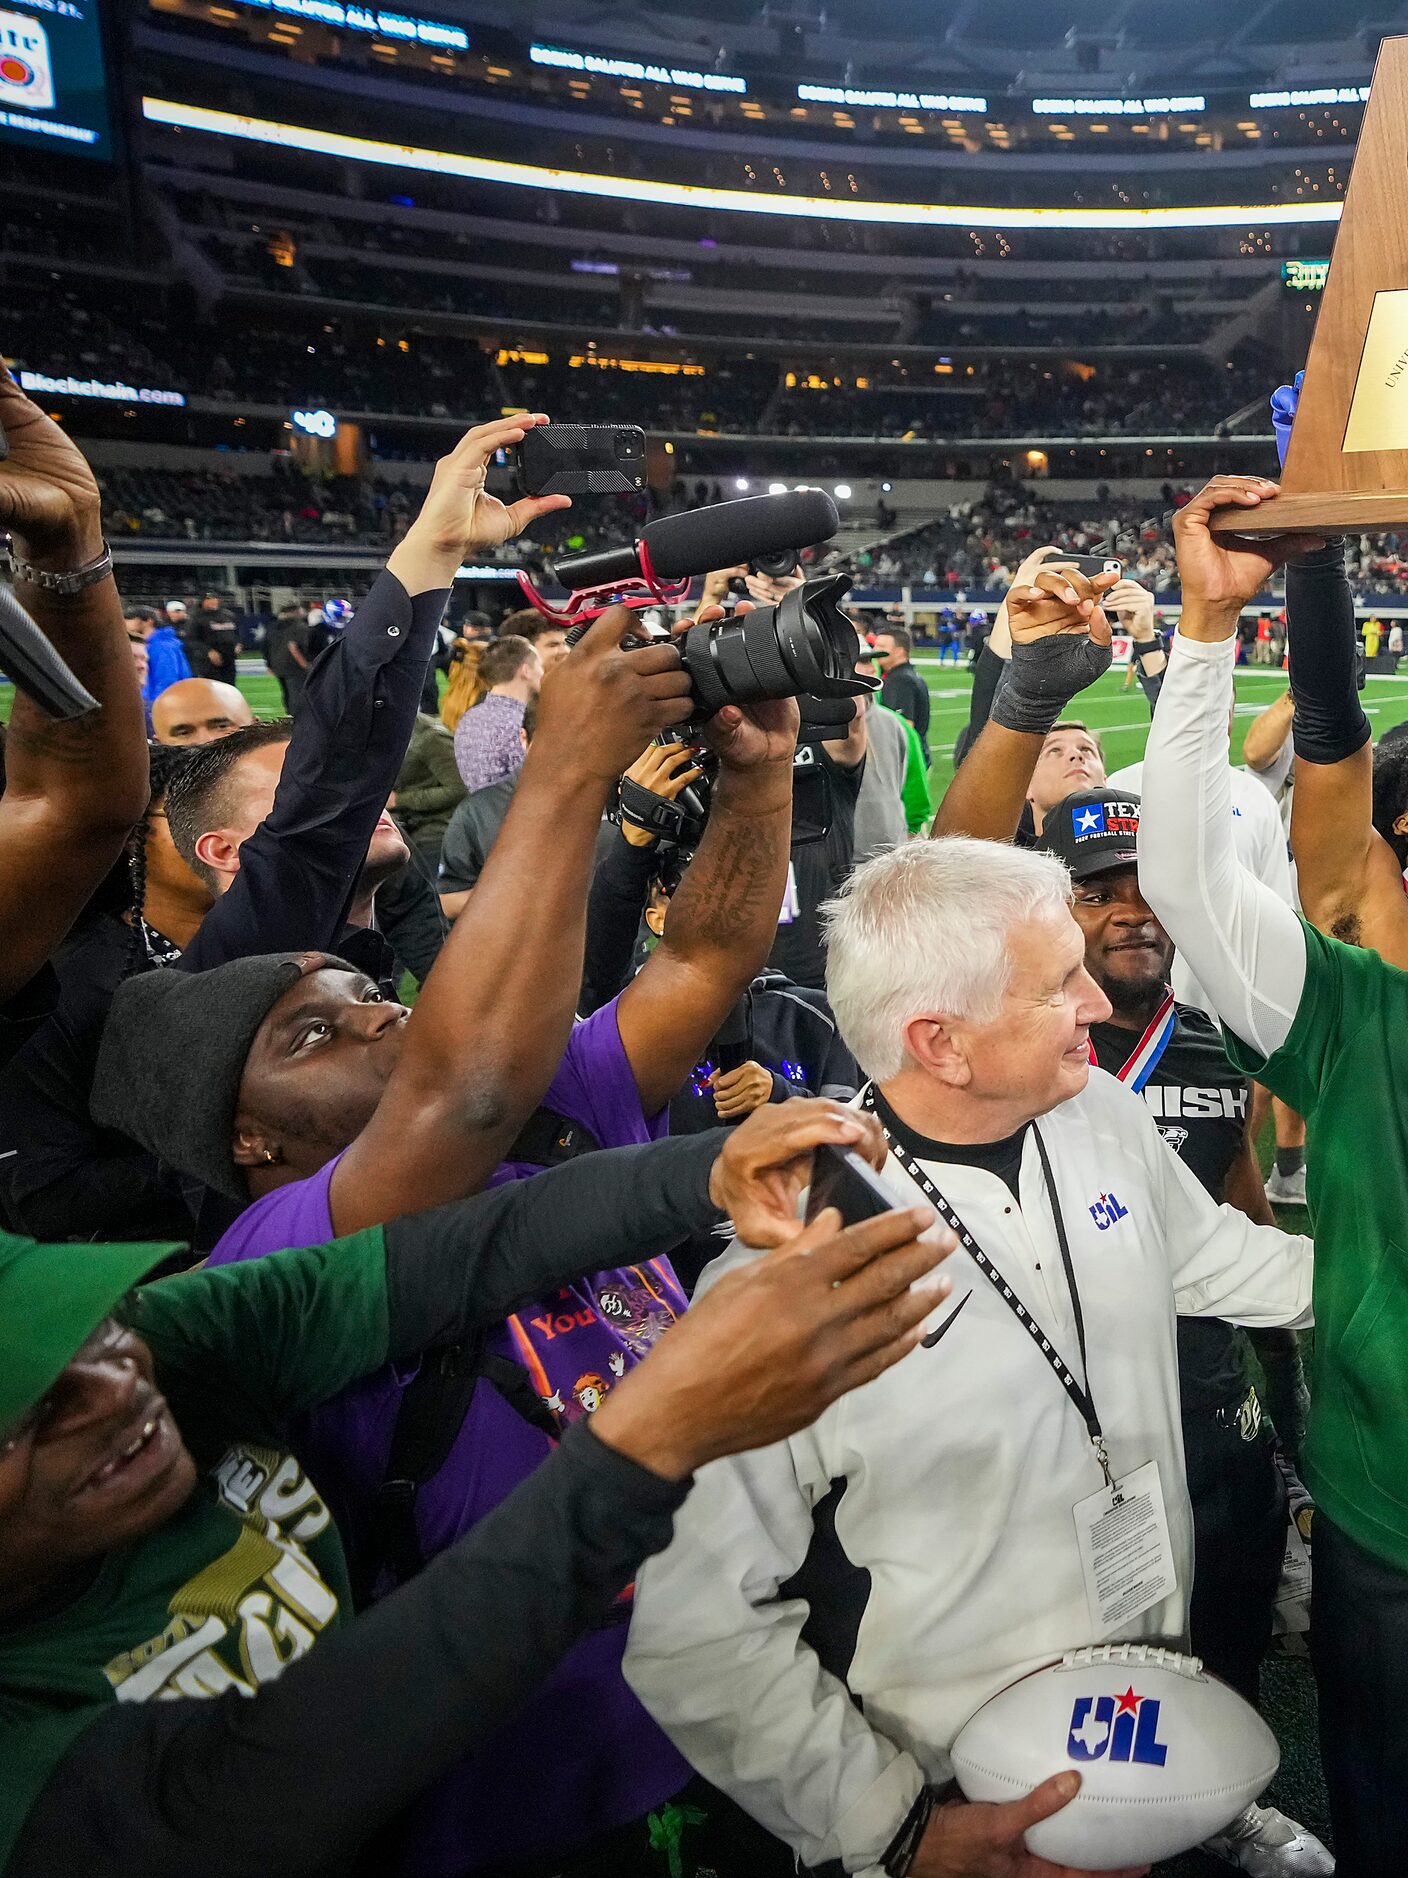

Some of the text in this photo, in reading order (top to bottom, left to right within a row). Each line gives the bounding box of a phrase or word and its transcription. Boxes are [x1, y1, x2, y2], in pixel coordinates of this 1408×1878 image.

[20, 371, 186, 407] Blockchain.com
[1090, 831, 1118, 840] FOOTBALL
[1088, 1191, 1129, 1231] UIL
[530, 1306, 597, 1341] You
[1066, 1686, 1168, 1767] UIL
